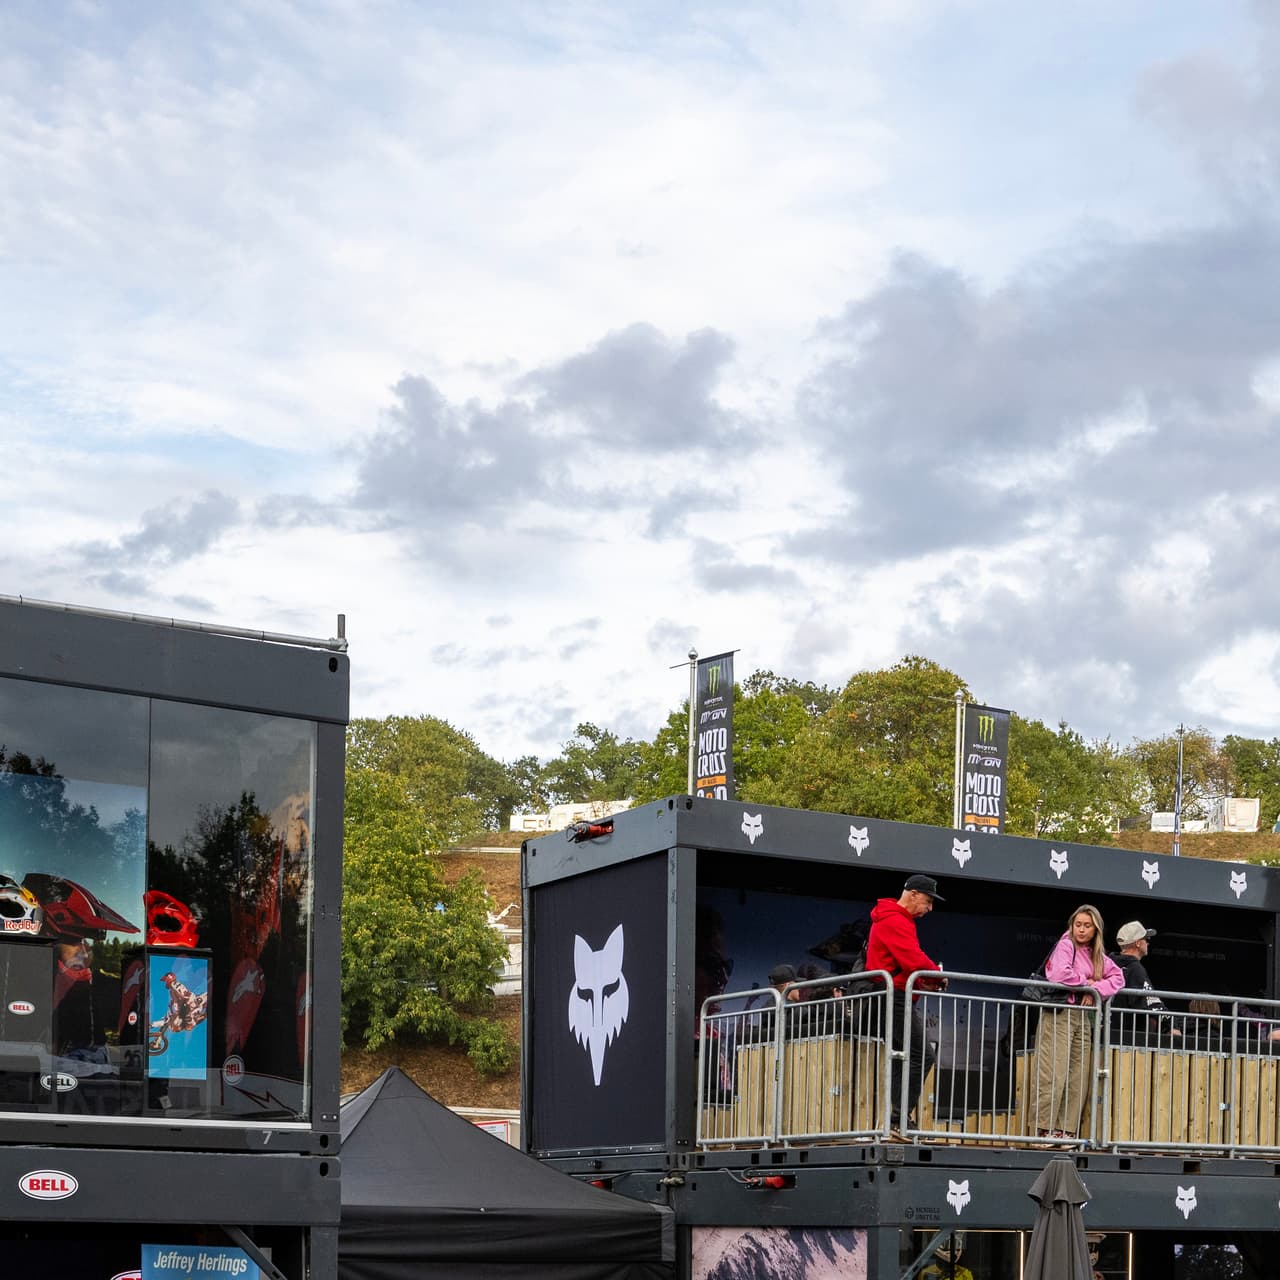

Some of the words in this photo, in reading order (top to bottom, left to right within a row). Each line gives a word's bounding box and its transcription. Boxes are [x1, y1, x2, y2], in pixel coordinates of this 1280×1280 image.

[698, 727, 727, 756] MOTO
[697, 751, 727, 777] CROSS
[966, 771, 1001, 798] MOTO
[965, 793, 999, 817] CROSS
[28, 1179, 69, 1192] BELL
[153, 1251, 195, 1273] Jeffrey
[197, 1253, 248, 1276] Herlings
